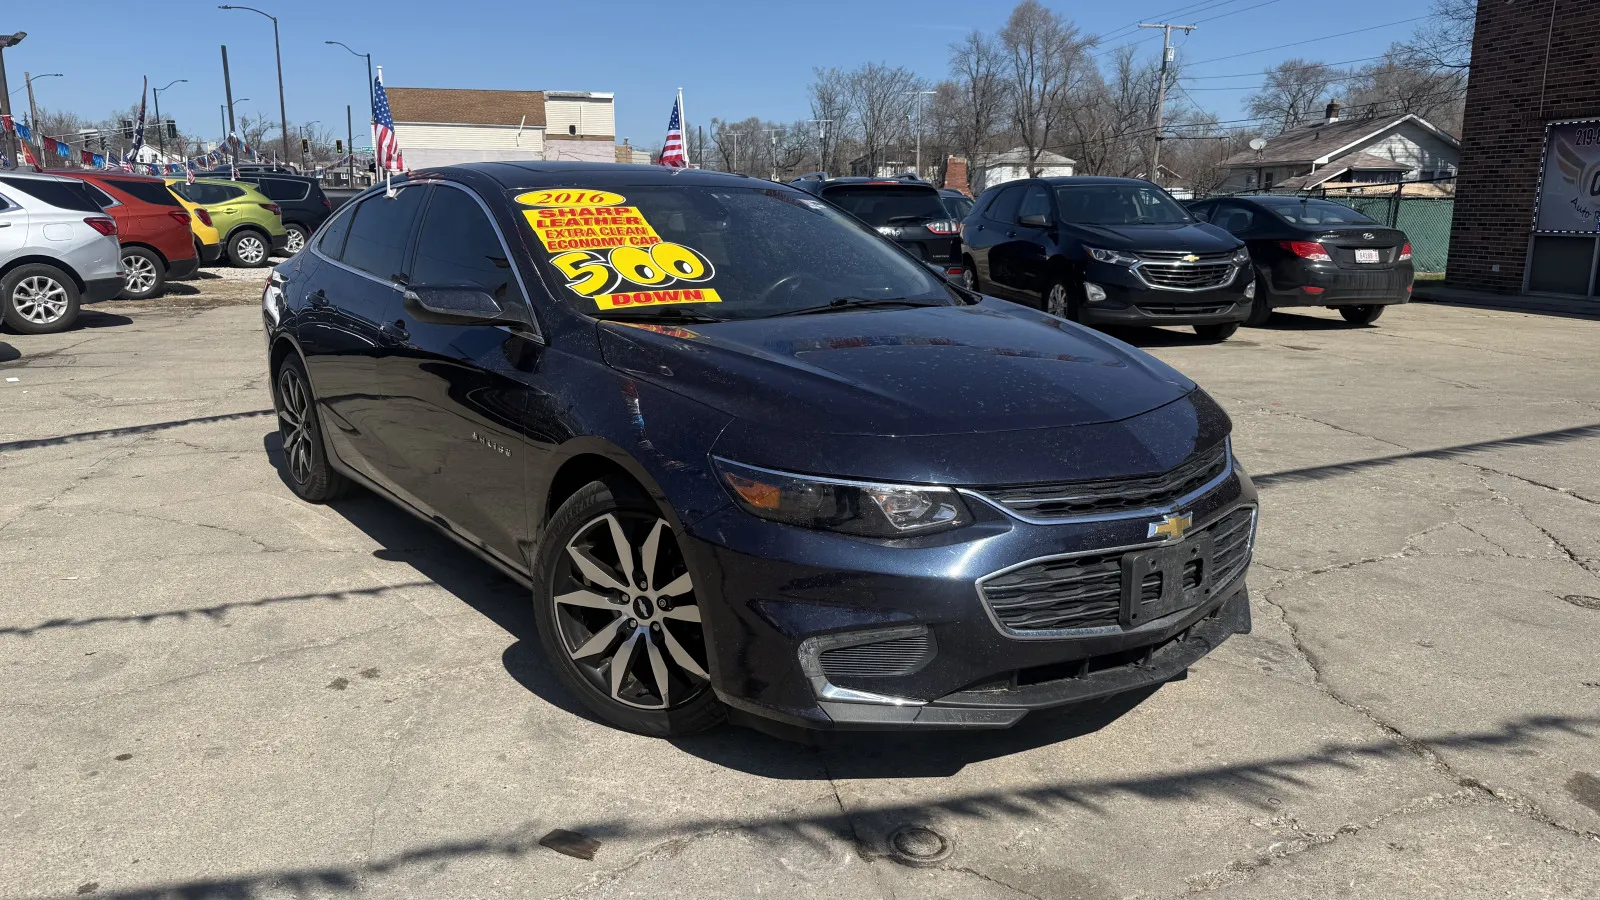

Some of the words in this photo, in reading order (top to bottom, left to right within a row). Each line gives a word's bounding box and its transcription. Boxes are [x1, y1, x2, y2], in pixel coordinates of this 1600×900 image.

[536, 192, 605, 204] 2016
[537, 207, 632, 218] SHARP
[1571, 197, 1592, 219] Auto
[536, 216, 643, 229] LEATHER
[545, 228, 599, 239] EXTRA
[599, 226, 649, 237] CLEAN
[547, 236, 626, 251] ECONOMY
[629, 236, 661, 246] CAR
[549, 242, 716, 298] 500
[611, 289, 705, 306] DOWN
